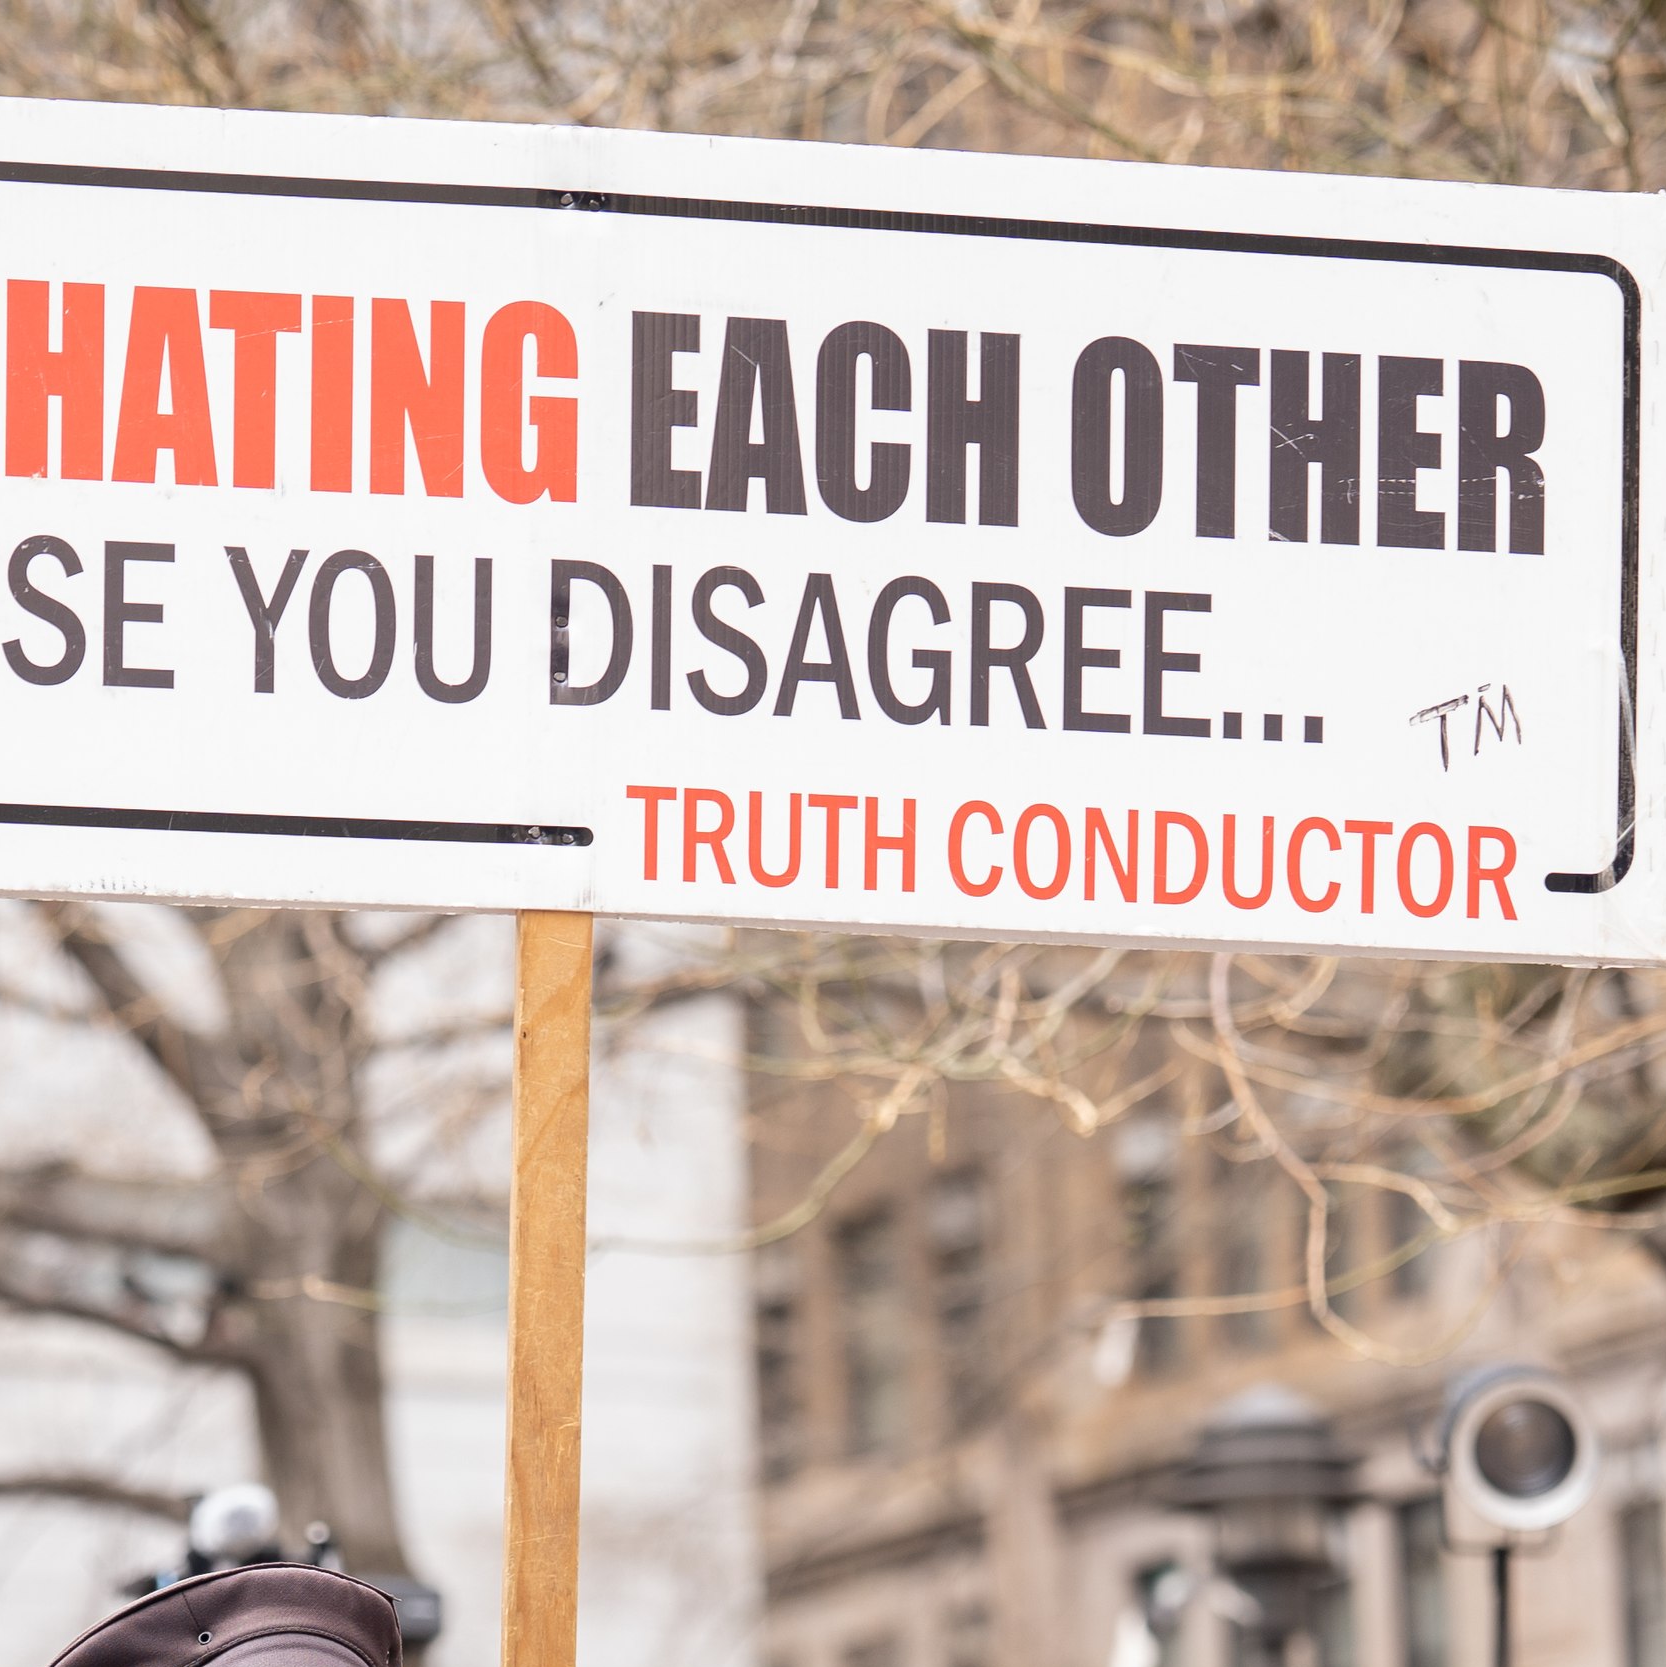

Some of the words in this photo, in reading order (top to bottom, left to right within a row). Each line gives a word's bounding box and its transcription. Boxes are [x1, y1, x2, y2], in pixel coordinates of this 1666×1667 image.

[4, 278, 579, 505] HATING
[630, 310, 1021, 528] EACH
[1071, 336, 1546, 556] OTHER
[224, 546, 493, 704] YOU
[547, 558, 1324, 744] DISAGREE...
[1409, 683, 1522, 772] TM
[626, 785, 917, 893] TRUTH
[947, 799, 1518, 921] CONDUCTOR
